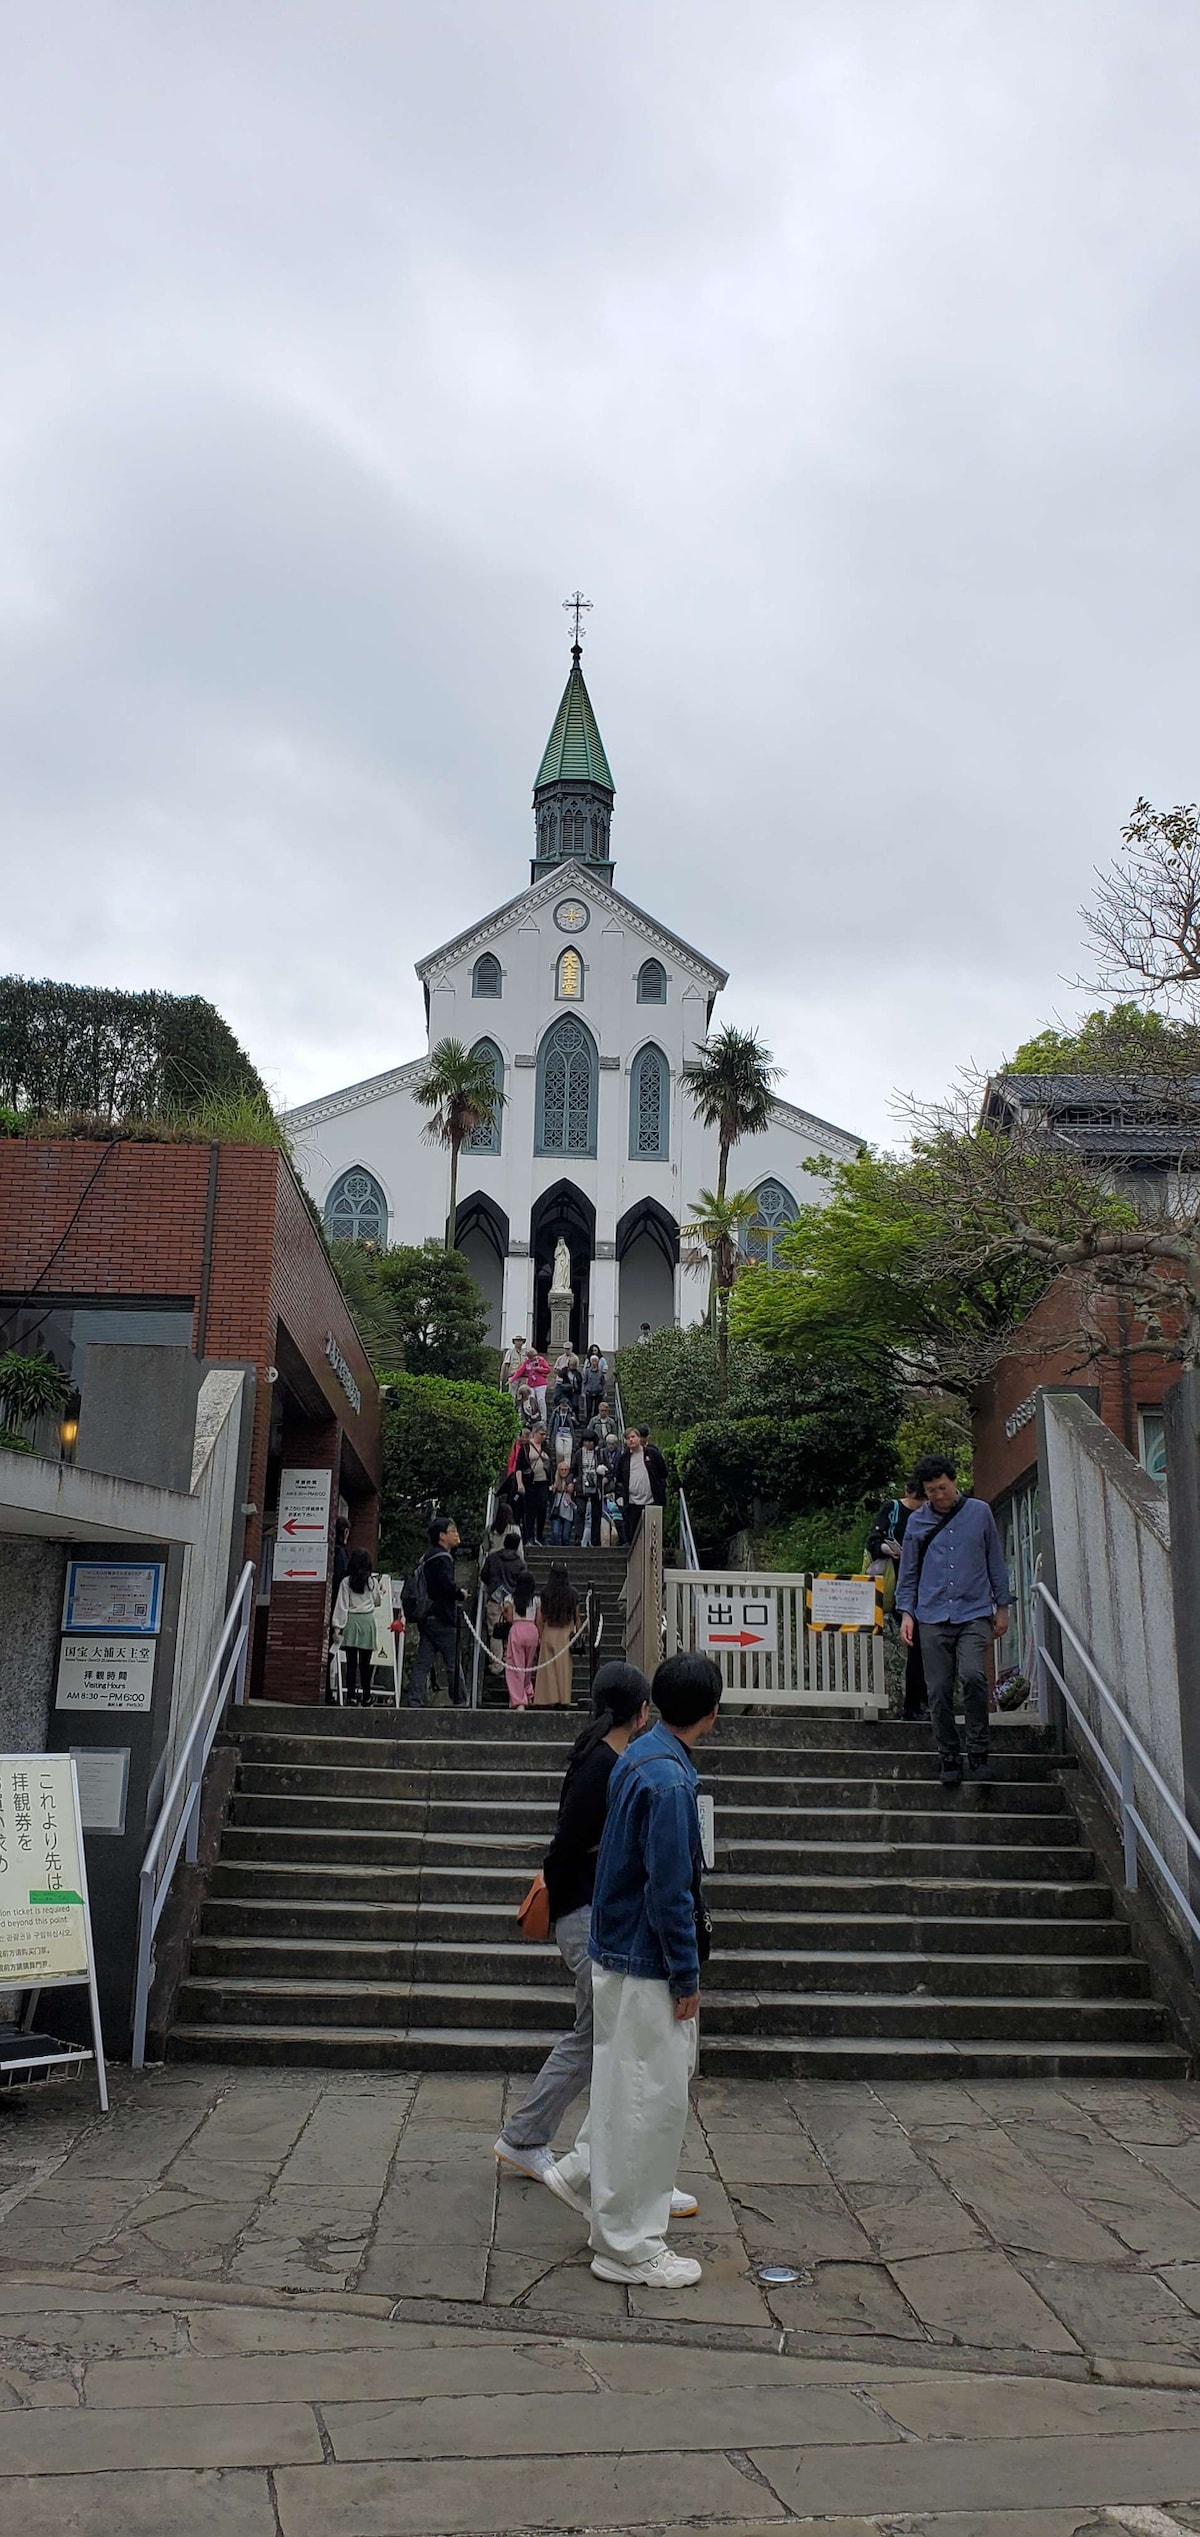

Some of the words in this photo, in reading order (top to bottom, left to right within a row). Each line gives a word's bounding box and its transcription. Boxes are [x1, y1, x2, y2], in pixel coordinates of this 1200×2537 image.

[561, 954, 579, 996] 天主堂
[707, 1603, 768, 1625] 出口
[65, 1646, 88, 1658] 国宝
[92, 1646, 150, 1659] 大浦天主堂
[84, 1682, 107, 1690] Visiting
[107, 1682, 126, 1690] Hours
[11, 1773, 32, 1851] 拝観券を
[40, 1773, 63, 1891] これより先は
[13, 1907, 34, 1916] ticket
[35, 1906, 42, 1915] is
[42, 1904, 71, 1914] required
[7, 1918, 34, 1929] beyond
[35, 1917, 48, 1926] this
